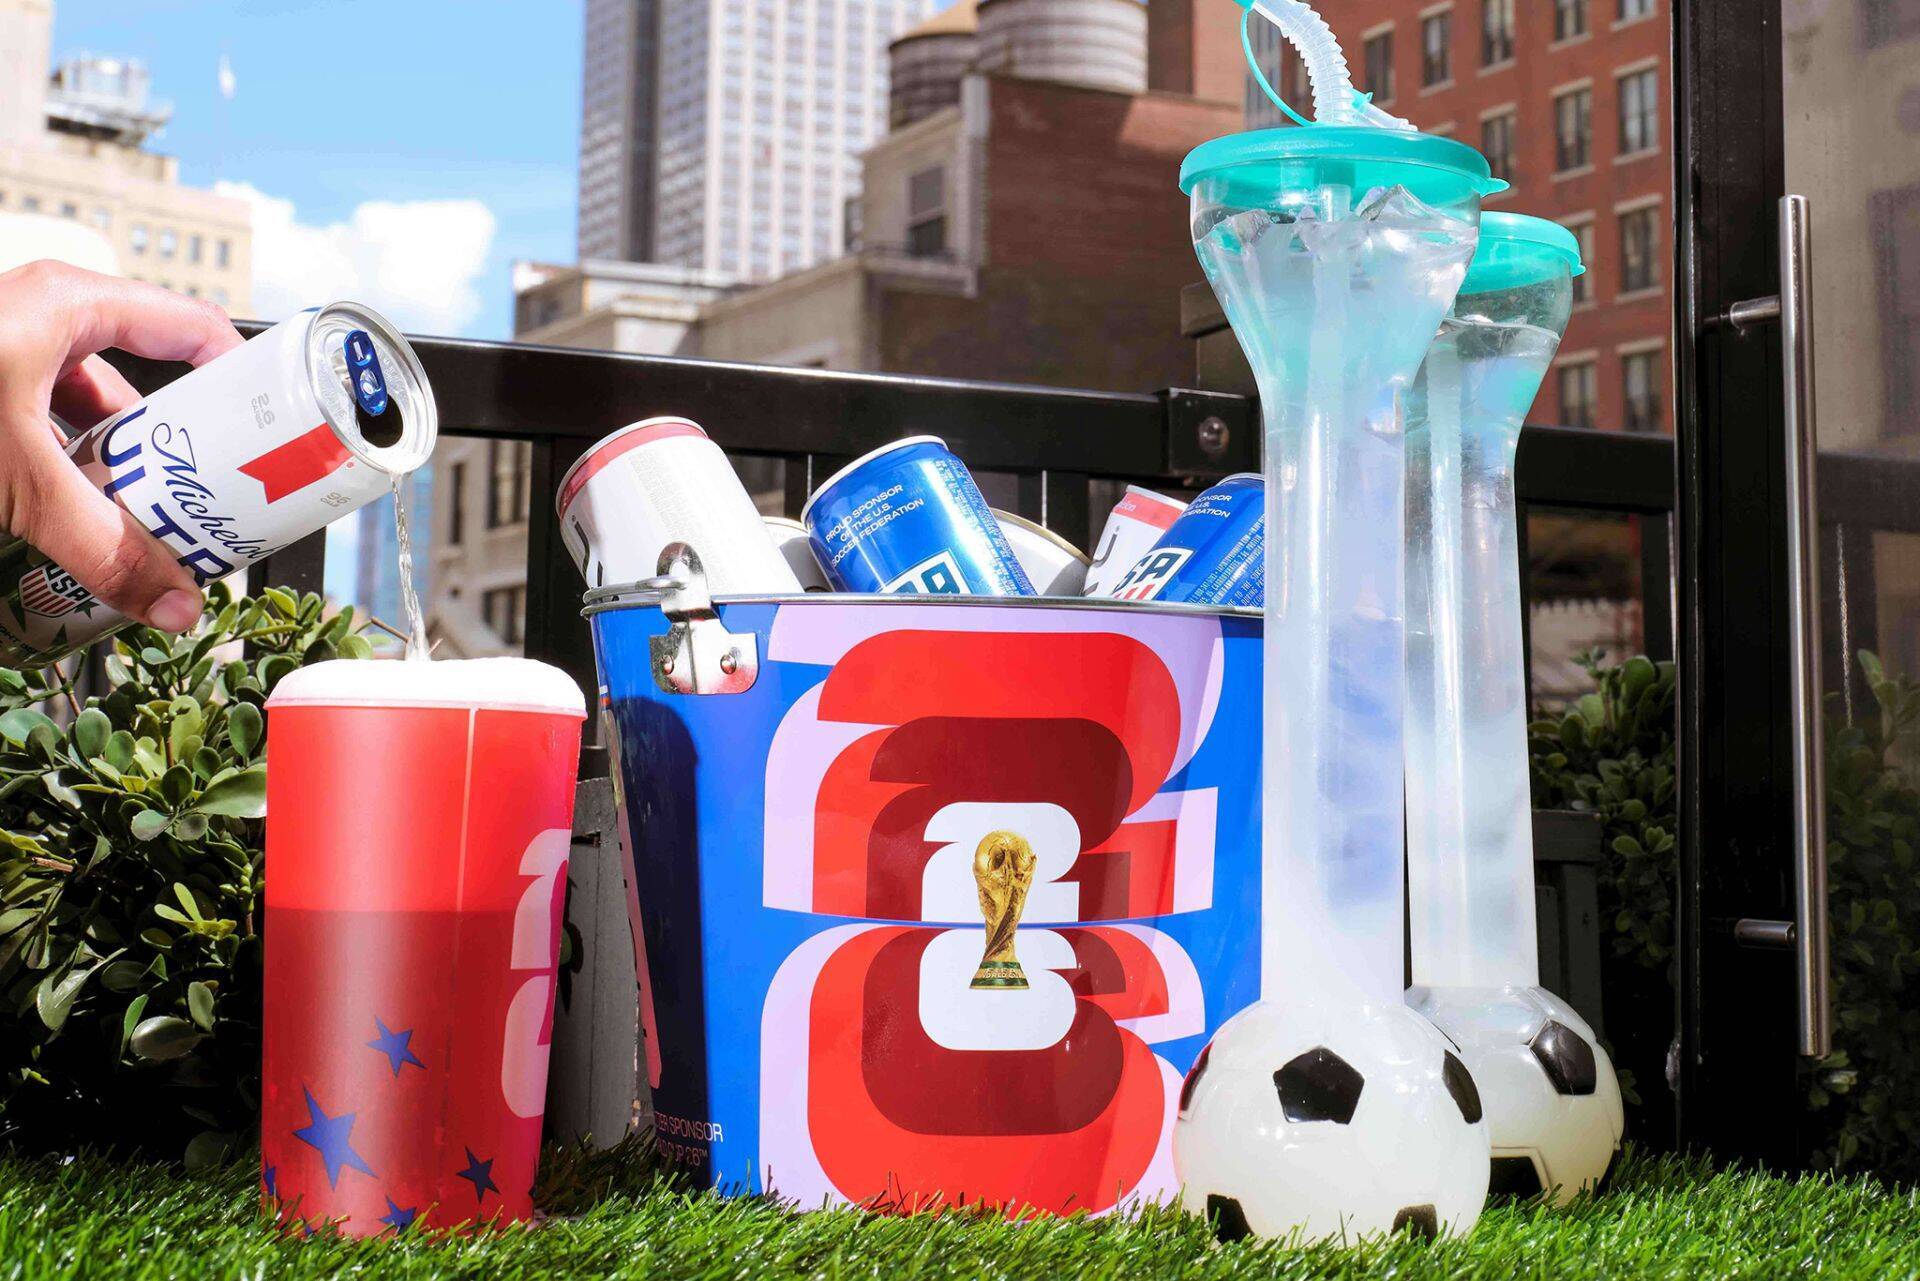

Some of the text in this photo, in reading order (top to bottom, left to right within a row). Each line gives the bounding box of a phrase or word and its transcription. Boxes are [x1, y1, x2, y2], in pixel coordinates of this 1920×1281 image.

[101, 406, 235, 587] ULTR
[151, 422, 289, 560] Michelob
[825, 484, 904, 543] PROUD SPONSOR
[840, 502, 894, 542] OF THE U.S.
[832, 497, 925, 568] SOCCER FEDERATION
[668, 1116, 724, 1142] SPONSOR
